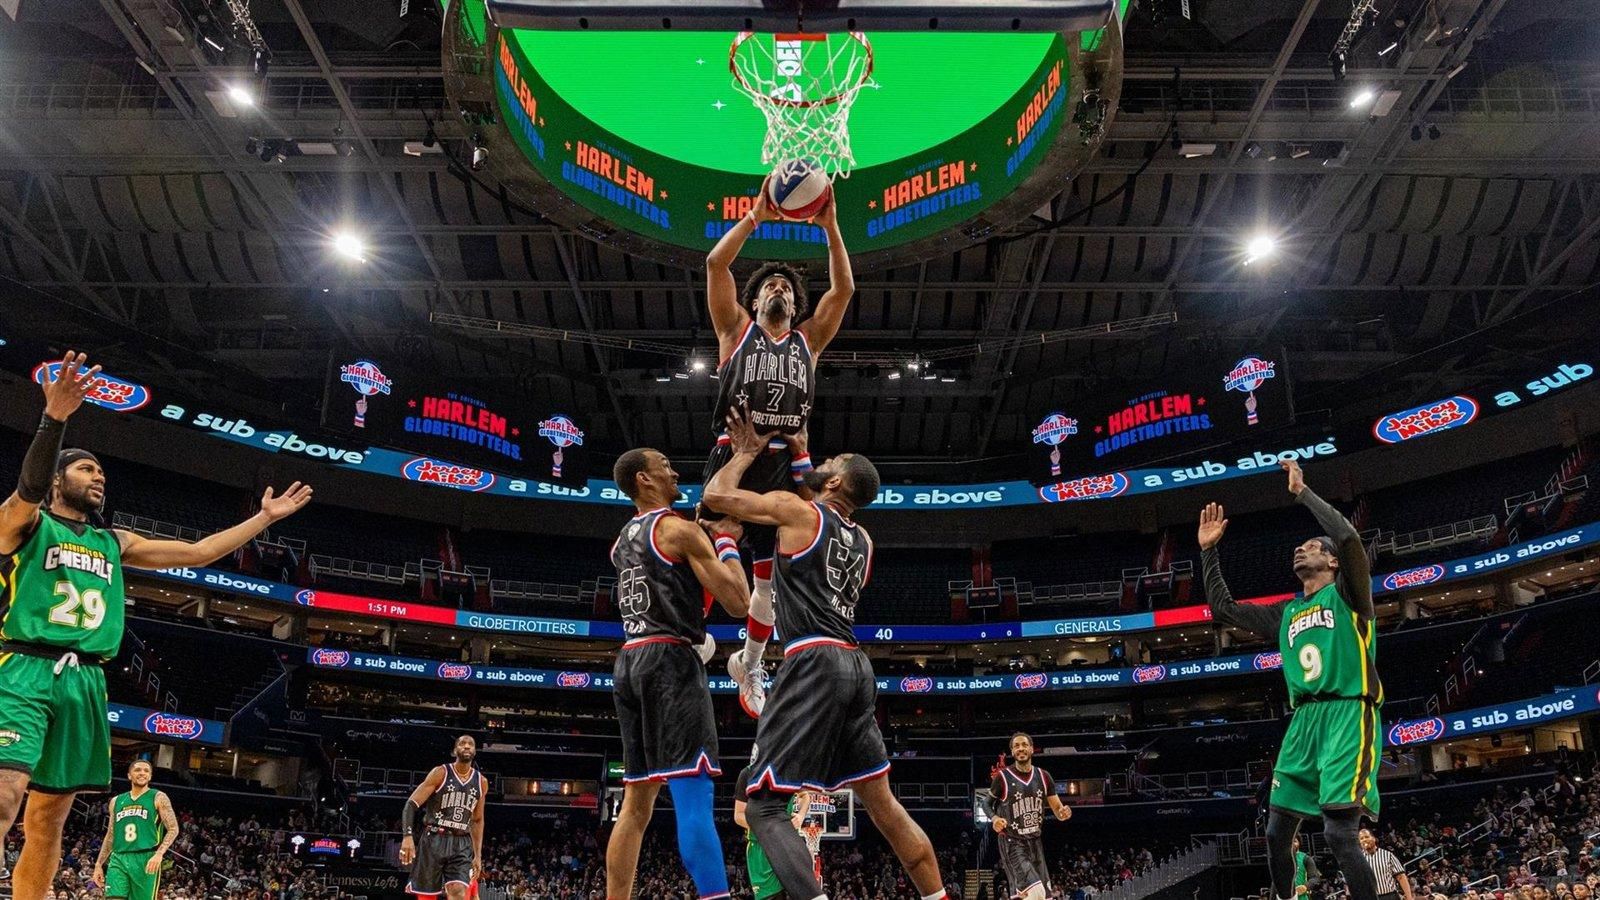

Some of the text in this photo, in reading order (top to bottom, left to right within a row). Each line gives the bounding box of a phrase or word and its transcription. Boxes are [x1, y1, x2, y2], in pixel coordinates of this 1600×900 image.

[1017, 60, 1061, 145] HARLEM
[576, 140, 654, 202] HARLEM
[562, 161, 670, 229] GLOBETROTTERS
[884, 160, 965, 212] HARLEM
[867, 182, 980, 237] GLOBETROTTERS
[348, 365, 386, 384] HARLEM
[744, 353, 807, 393] HARLEM
[1230, 361, 1267, 380] HARLEM
[1495, 363, 1593, 406] a sub
[766, 383, 785, 412] 7
[161, 404, 185, 420] a
[193, 413, 255, 437] sub
[423, 397, 507, 438] HARLEM
[1108, 394, 1192, 435] HARLEM
[1387, 400, 1459, 432] Jersey
[545, 421, 578, 436] HARLEM
[1038, 418, 1072, 433] HARLEM
[404, 417, 521, 459] GLOBETROTTERS
[1095, 414, 1212, 458] GLOBETROTTERS
[416, 461, 485, 478] Jersey
[1144, 474, 1163, 487] a
[1171, 460, 1226, 482] sub
[509, 480, 526, 492] a
[1051, 474, 1115, 491] Jersey
[1454, 564, 1468, 573] a
[1474, 553, 1510, 569] sub
[49, 581, 107, 631] 29
[368, 603, 406, 615] 1:51 PM
[469, 616, 576, 634] GLOBETROTTERS
[875, 628, 893, 640] 40
[1055, 620, 1121, 634] GENERALS
[354, 657, 361, 665] a
[365, 658, 386, 668] sub
[1170, 668, 1177, 676] a
[1181, 664, 1201, 674] sub
[1299, 643, 1322, 682] 9
[476, 671, 483, 679] a
[486, 671, 507, 680] sub
[594, 678, 601, 686] a
[709, 679, 738, 688] a sub
[937, 681, 943, 689] a
[947, 680, 966, 689] sub
[1062, 674, 1082, 684] sub
[152, 715, 195, 726] Jersey
[1396, 718, 1435, 736] Jersey
[1453, 720, 1465, 731] a
[1472, 712, 1508, 727] sub
[453, 807, 464, 822] 5
[125, 823, 137, 842] 8
[374, 876, 398, 889] Lofts
